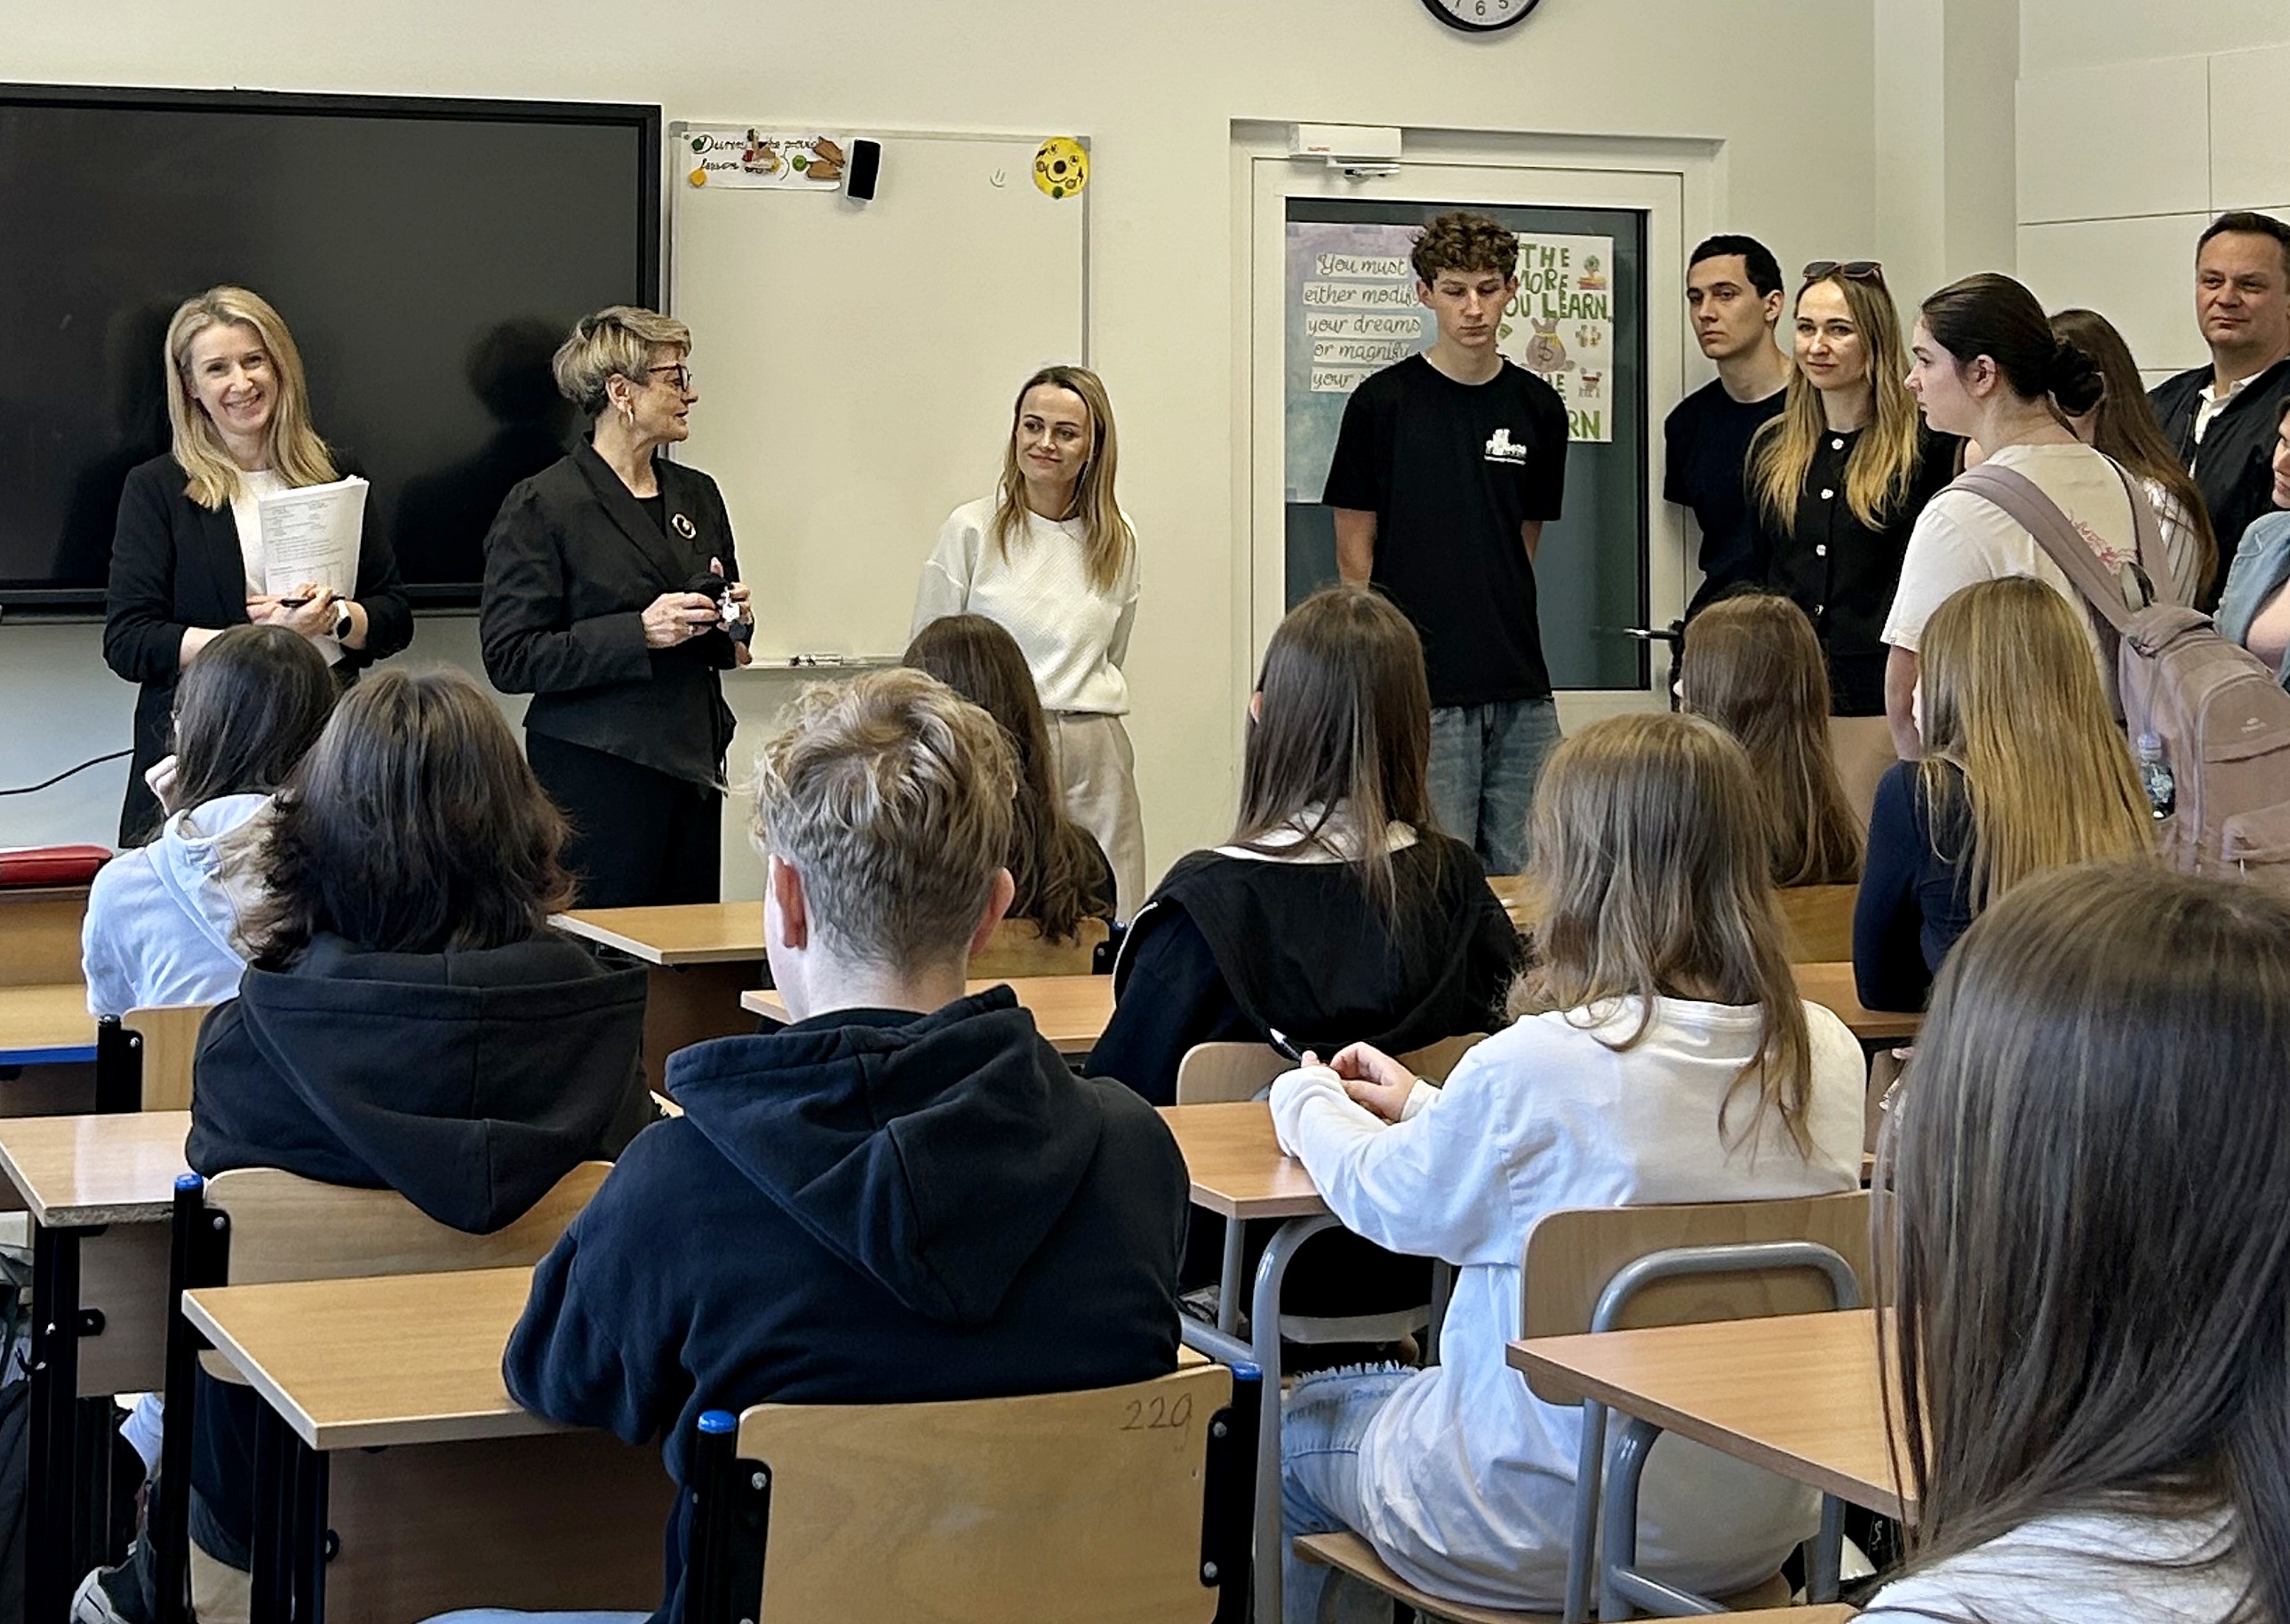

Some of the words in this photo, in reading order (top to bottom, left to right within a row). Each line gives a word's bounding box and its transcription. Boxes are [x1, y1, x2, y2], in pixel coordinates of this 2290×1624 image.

[1475, 0, 1485, 16] 6
[1317, 253, 1358, 275] You
[1360, 258, 1405, 276] must
[1520, 243, 1570, 269] THE
[1305, 284, 1358, 305] either
[1361, 284, 1420, 307] modify
[1503, 294, 1531, 317] OU
[1308, 319, 1349, 338] your
[1353, 314, 1421, 334] dreams
[1314, 344, 1335, 357] or
[1313, 373, 1354, 390] your
[1568, 410, 1600, 440] RN
